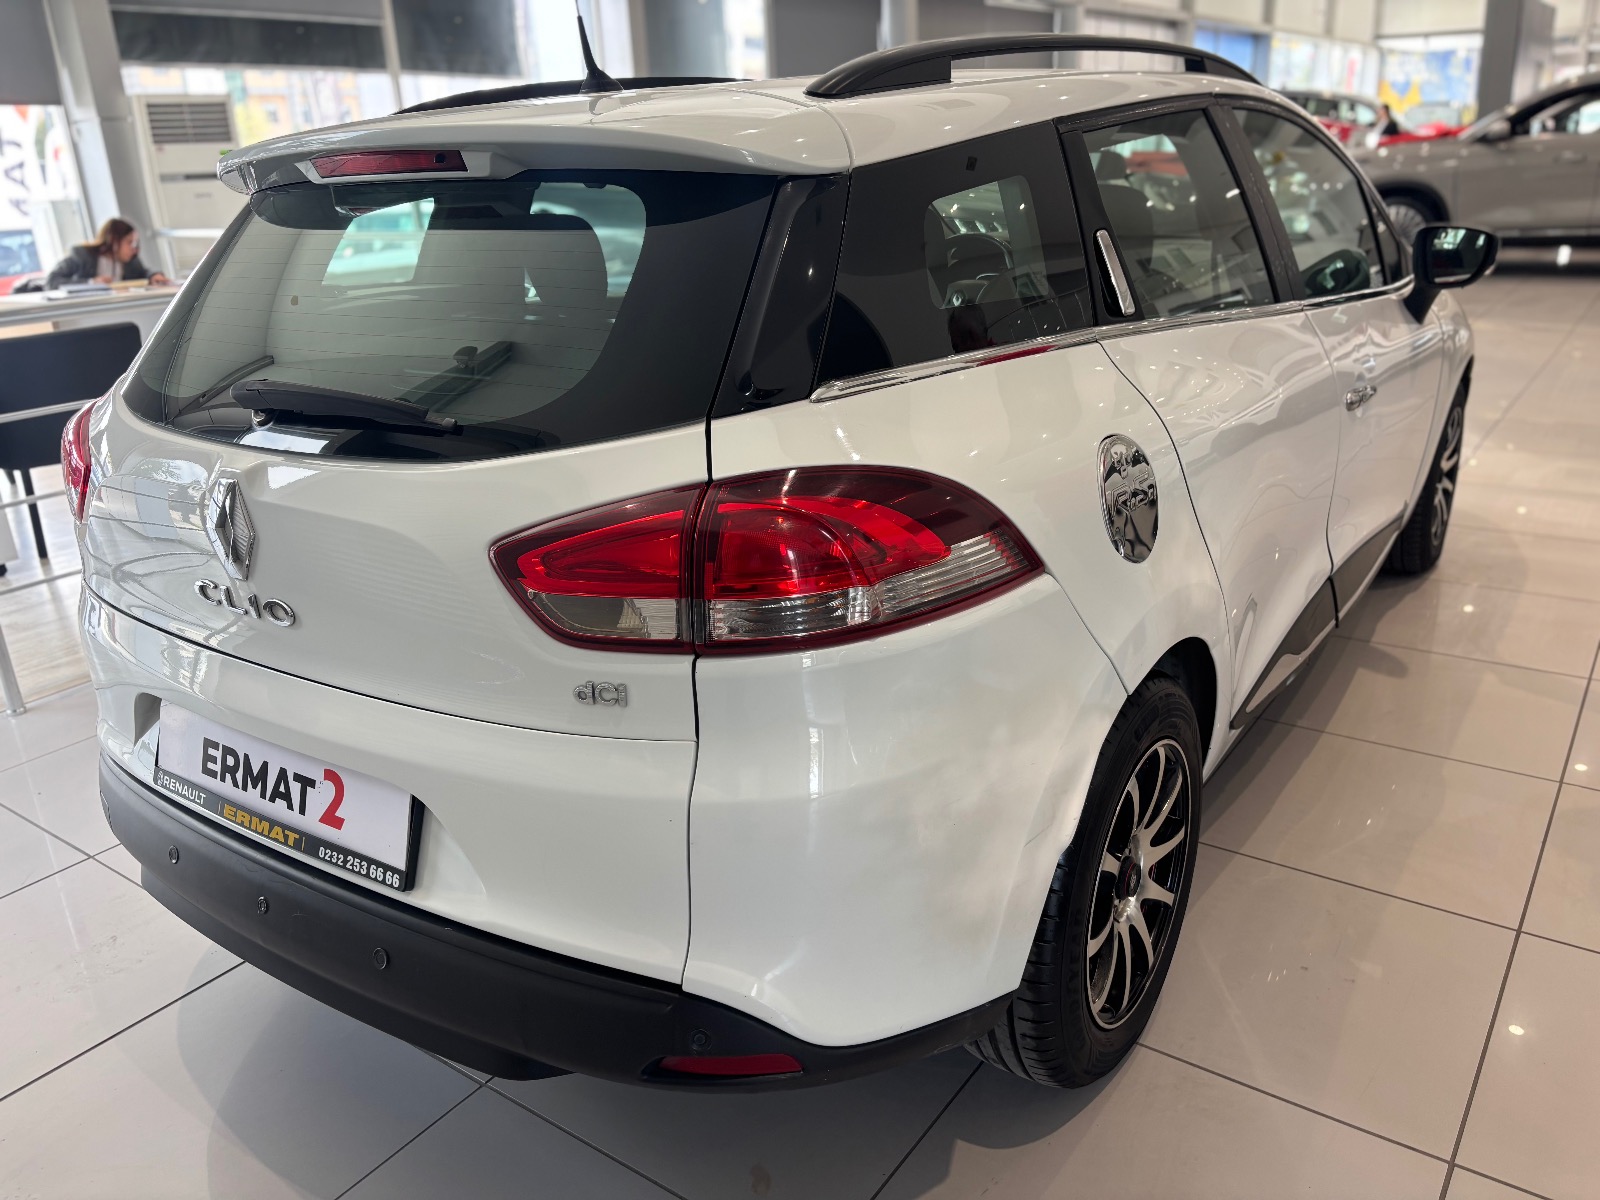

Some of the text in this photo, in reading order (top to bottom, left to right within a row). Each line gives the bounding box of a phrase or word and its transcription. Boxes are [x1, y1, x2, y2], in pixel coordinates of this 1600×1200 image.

[193, 579, 296, 627] CLIO
[163, 775, 400, 887] RENAULT ERMAT 0232 253 66 66
